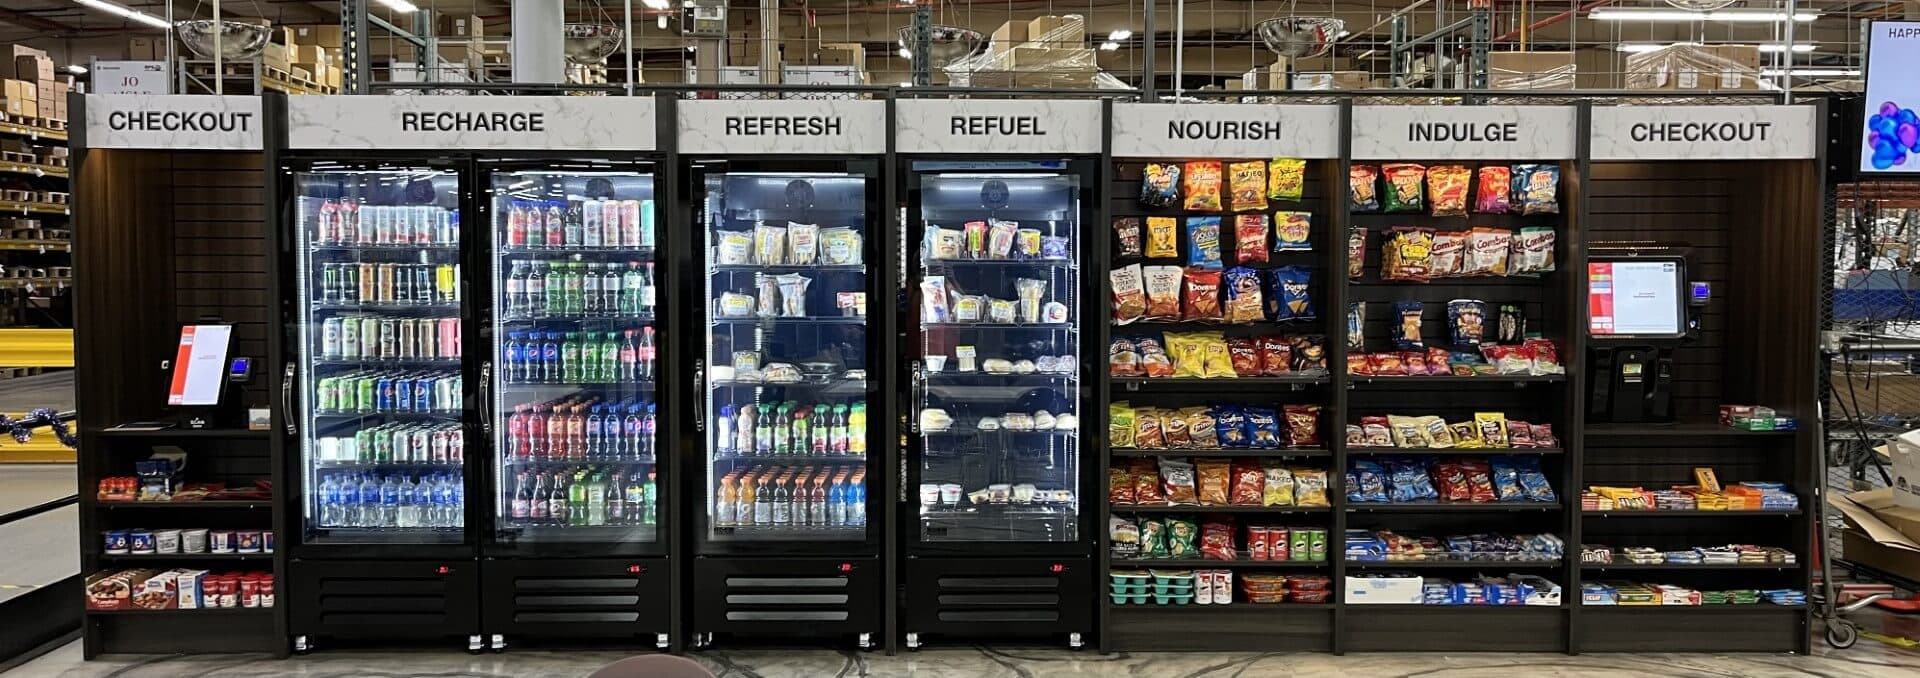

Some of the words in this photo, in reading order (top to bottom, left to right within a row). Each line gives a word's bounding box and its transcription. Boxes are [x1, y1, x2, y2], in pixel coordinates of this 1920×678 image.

[108, 111, 252, 132] CHECKOUT
[402, 111, 544, 132] RECHARGE
[725, 116, 842, 136] REFRESH
[951, 116, 1047, 136] REFUEL
[1168, 120, 1281, 141] NOURISH
[1408, 122, 1518, 142] INDULGE
[1630, 122, 1771, 142] CHECKOUT
[1432, 238, 1465, 251] Combos
[1525, 232, 1554, 247] Combos
[1264, 342, 1290, 352] Doritos
